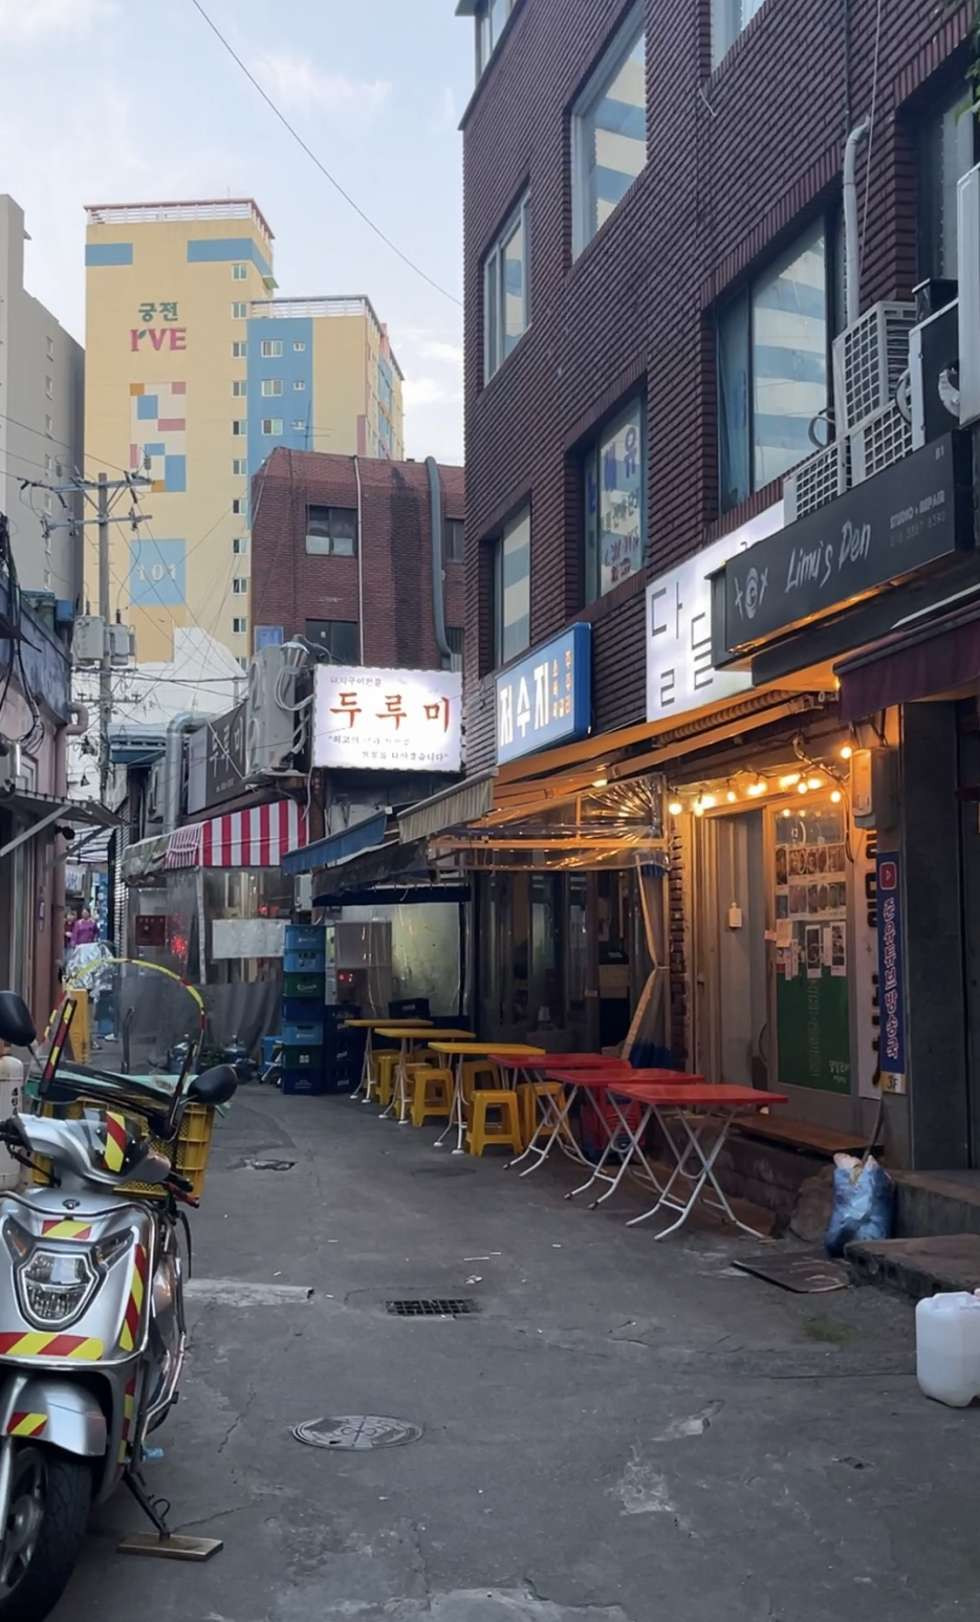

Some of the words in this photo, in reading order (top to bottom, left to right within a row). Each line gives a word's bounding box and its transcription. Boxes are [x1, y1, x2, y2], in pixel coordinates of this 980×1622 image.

[138, 301, 179, 322] 궁전
[784, 539, 832, 593] Limu's
[838, 520, 871, 570] Den
[136, 564, 177, 581] 101
[329, 691, 450, 732] 두루미
